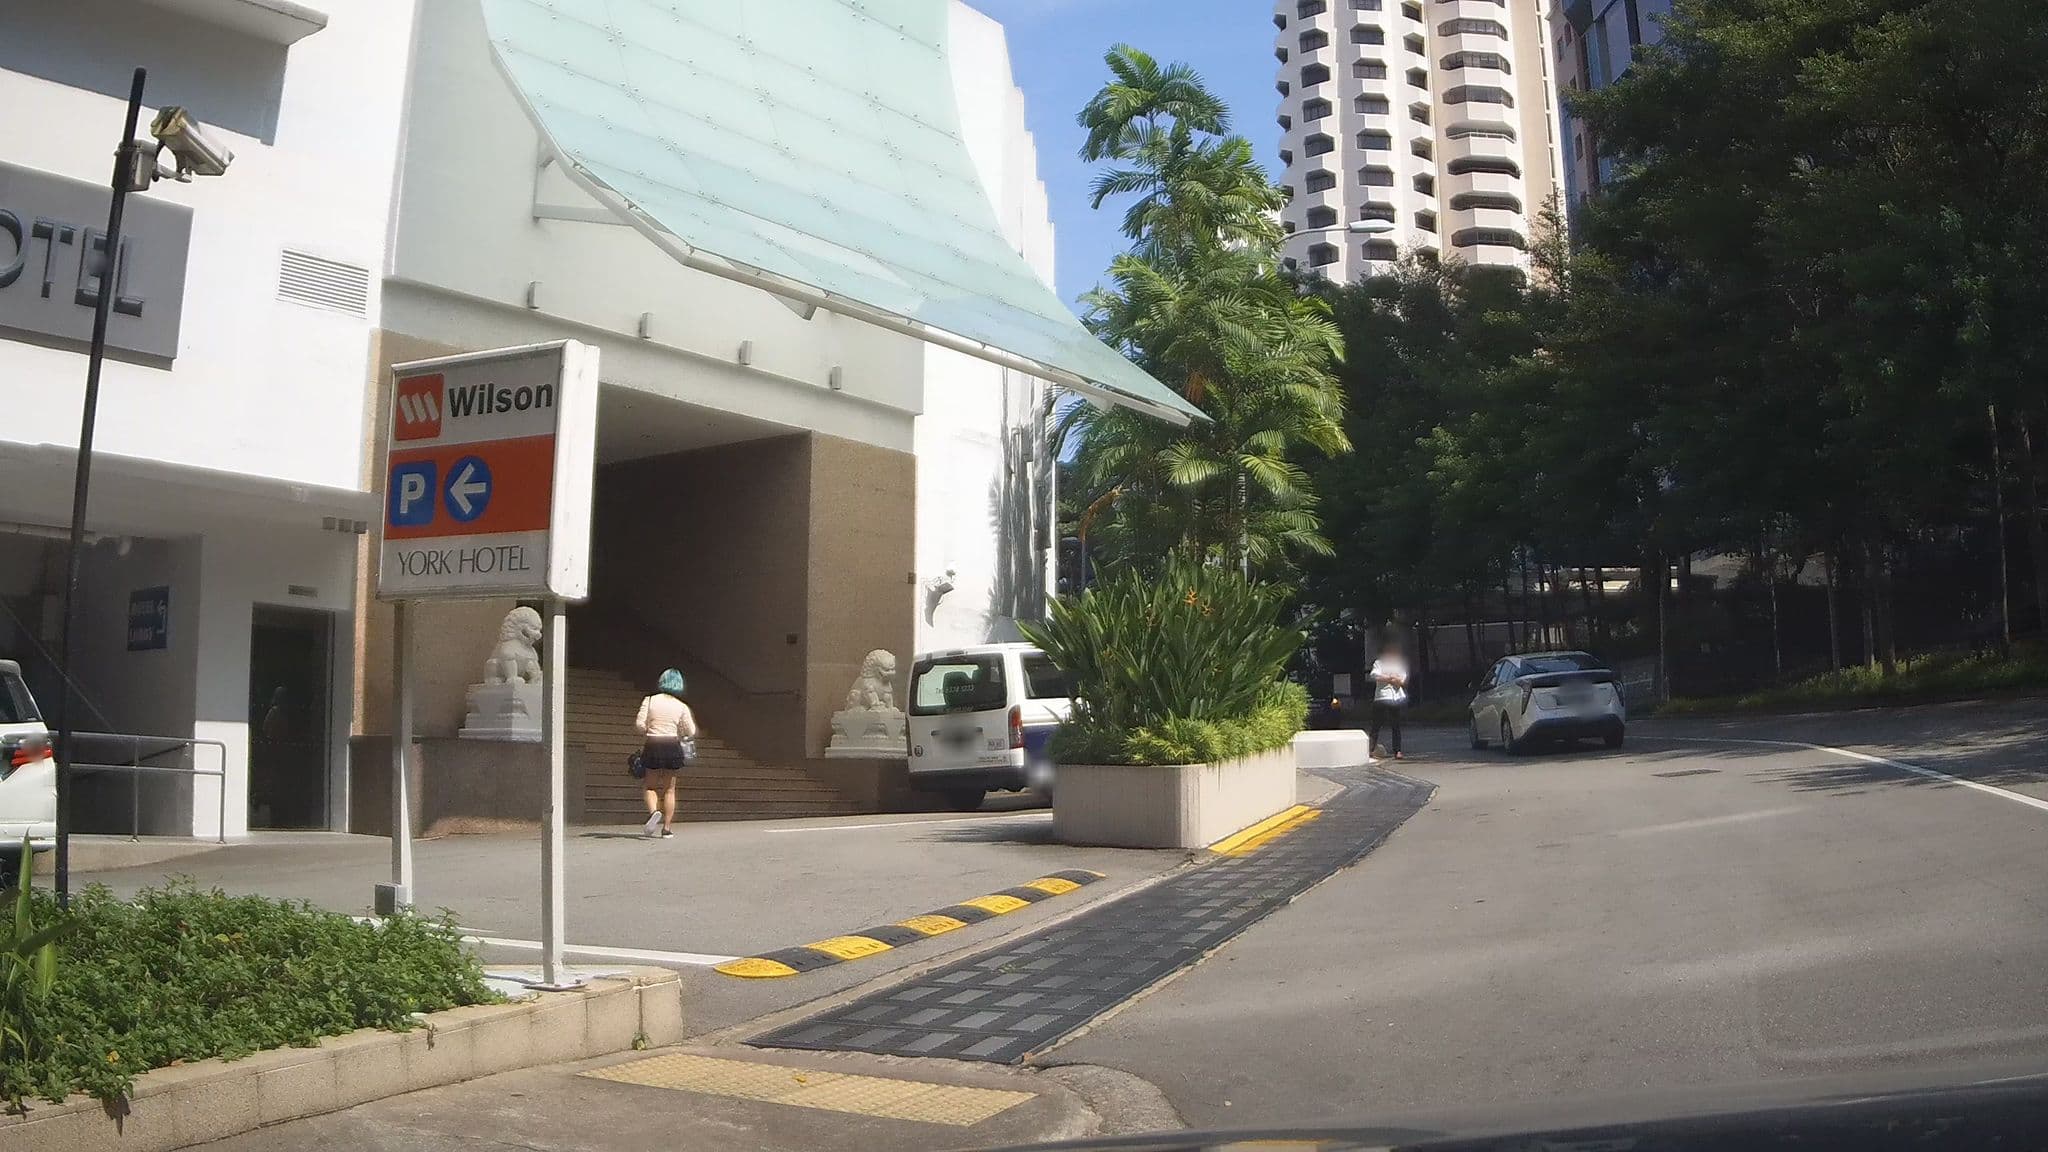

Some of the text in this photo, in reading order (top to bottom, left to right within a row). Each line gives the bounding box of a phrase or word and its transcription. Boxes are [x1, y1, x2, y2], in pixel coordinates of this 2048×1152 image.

[449, 383, 553, 418] Wilson
[399, 472, 426, 514] P
[398, 545, 530, 576] YORK HOTEL
